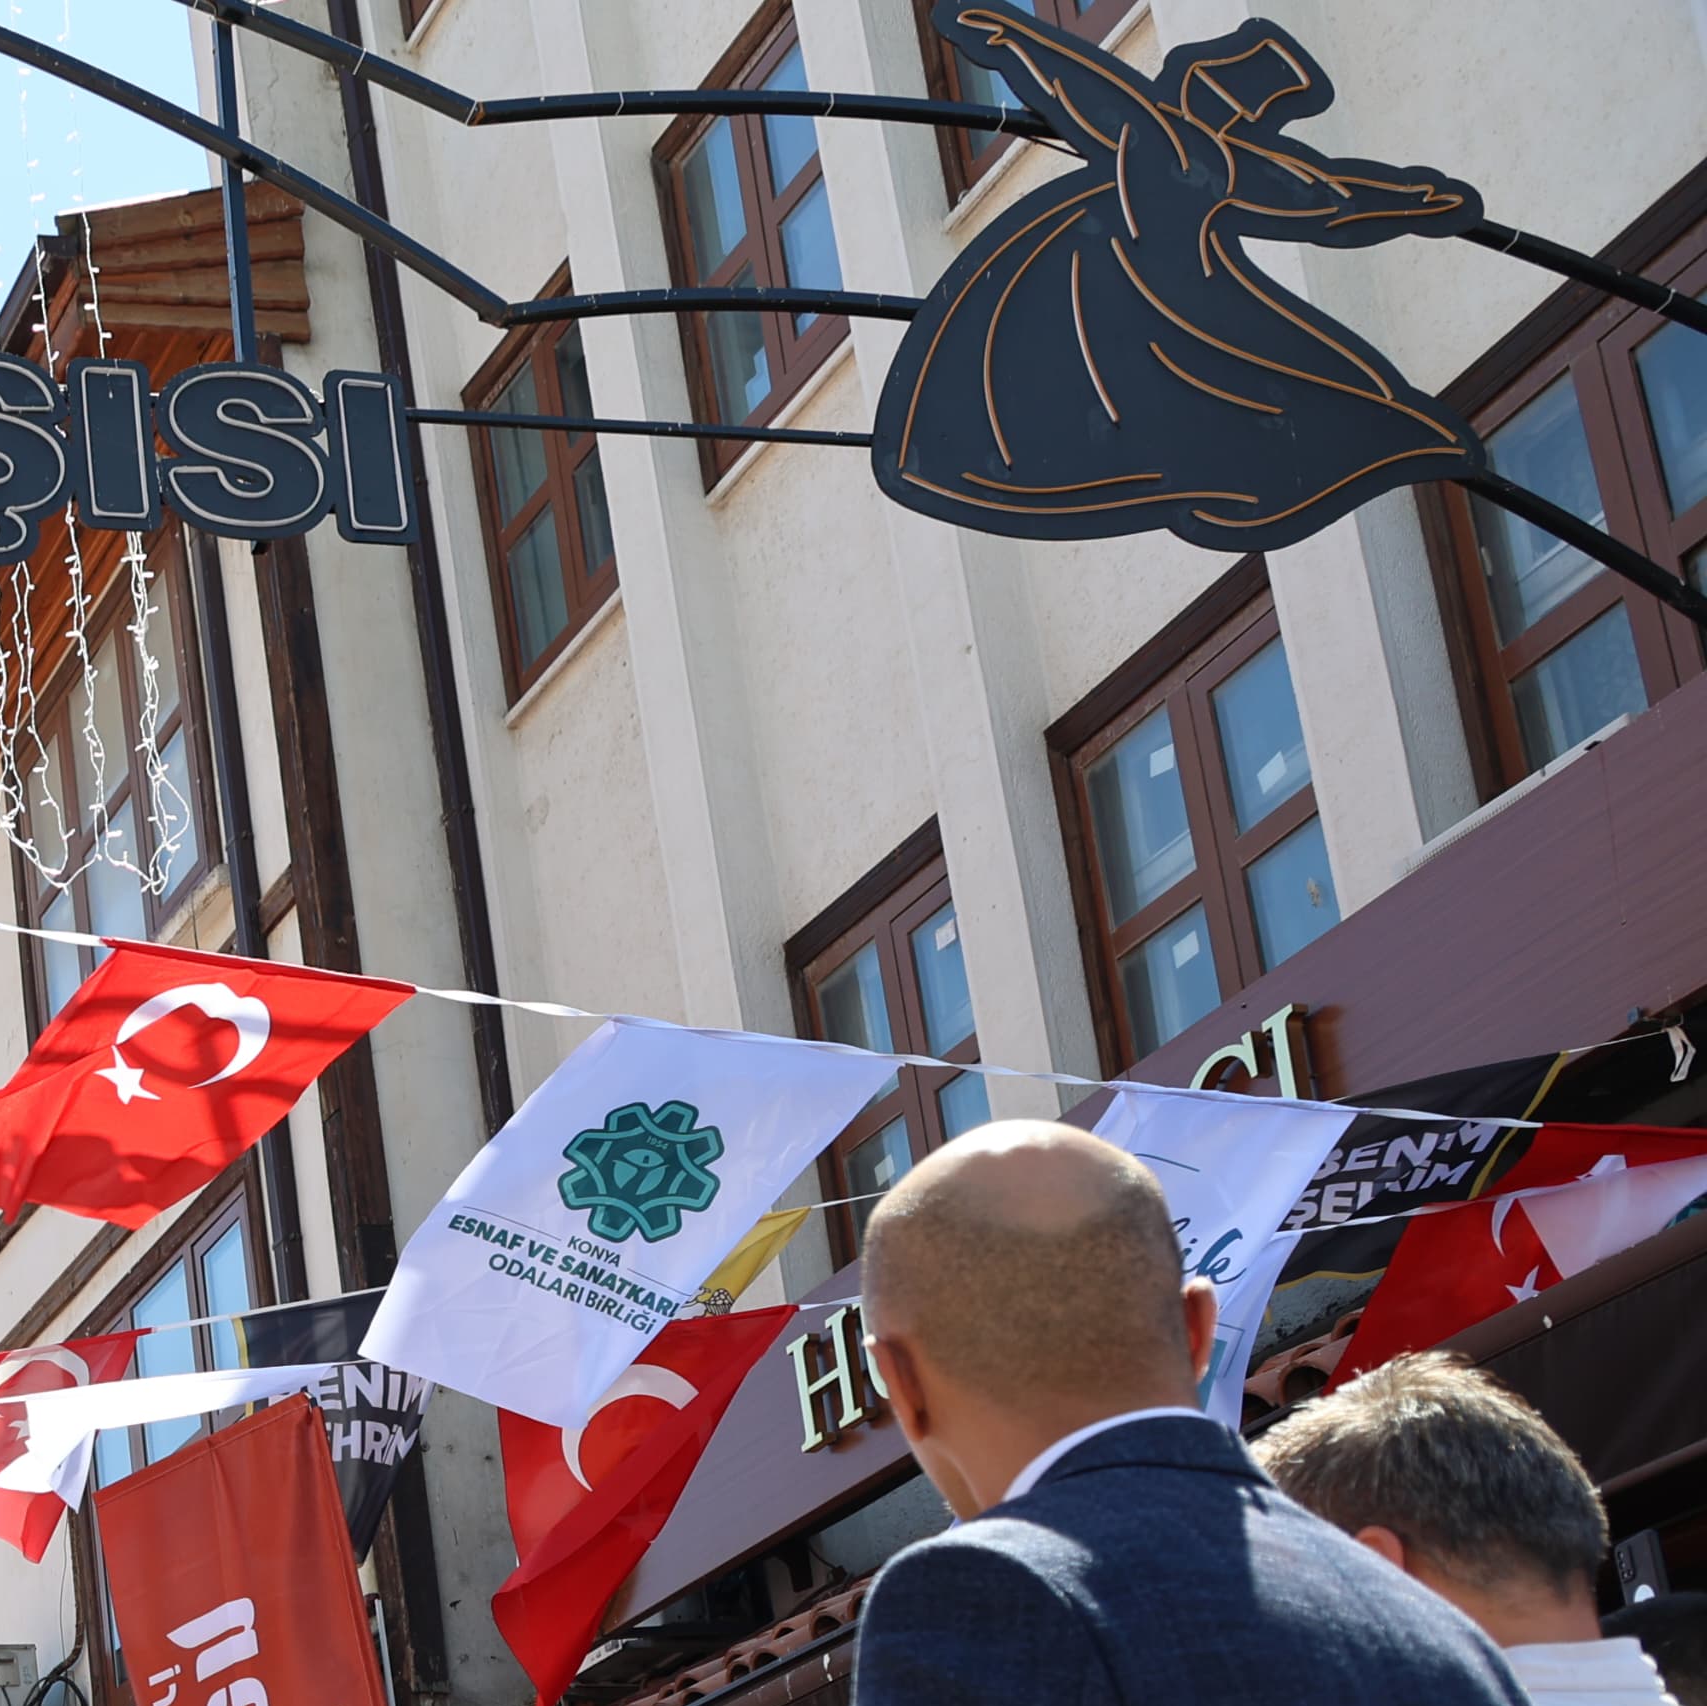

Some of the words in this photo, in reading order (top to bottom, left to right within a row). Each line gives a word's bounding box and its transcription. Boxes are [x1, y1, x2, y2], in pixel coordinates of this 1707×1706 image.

[645, 1135, 669, 1151] 1954
[448, 1214, 525, 1251] ESNAF
[527, 1239, 559, 1266] VE
[567, 1235, 622, 1267] KONYA
[488, 1253, 583, 1304] ODALARI
